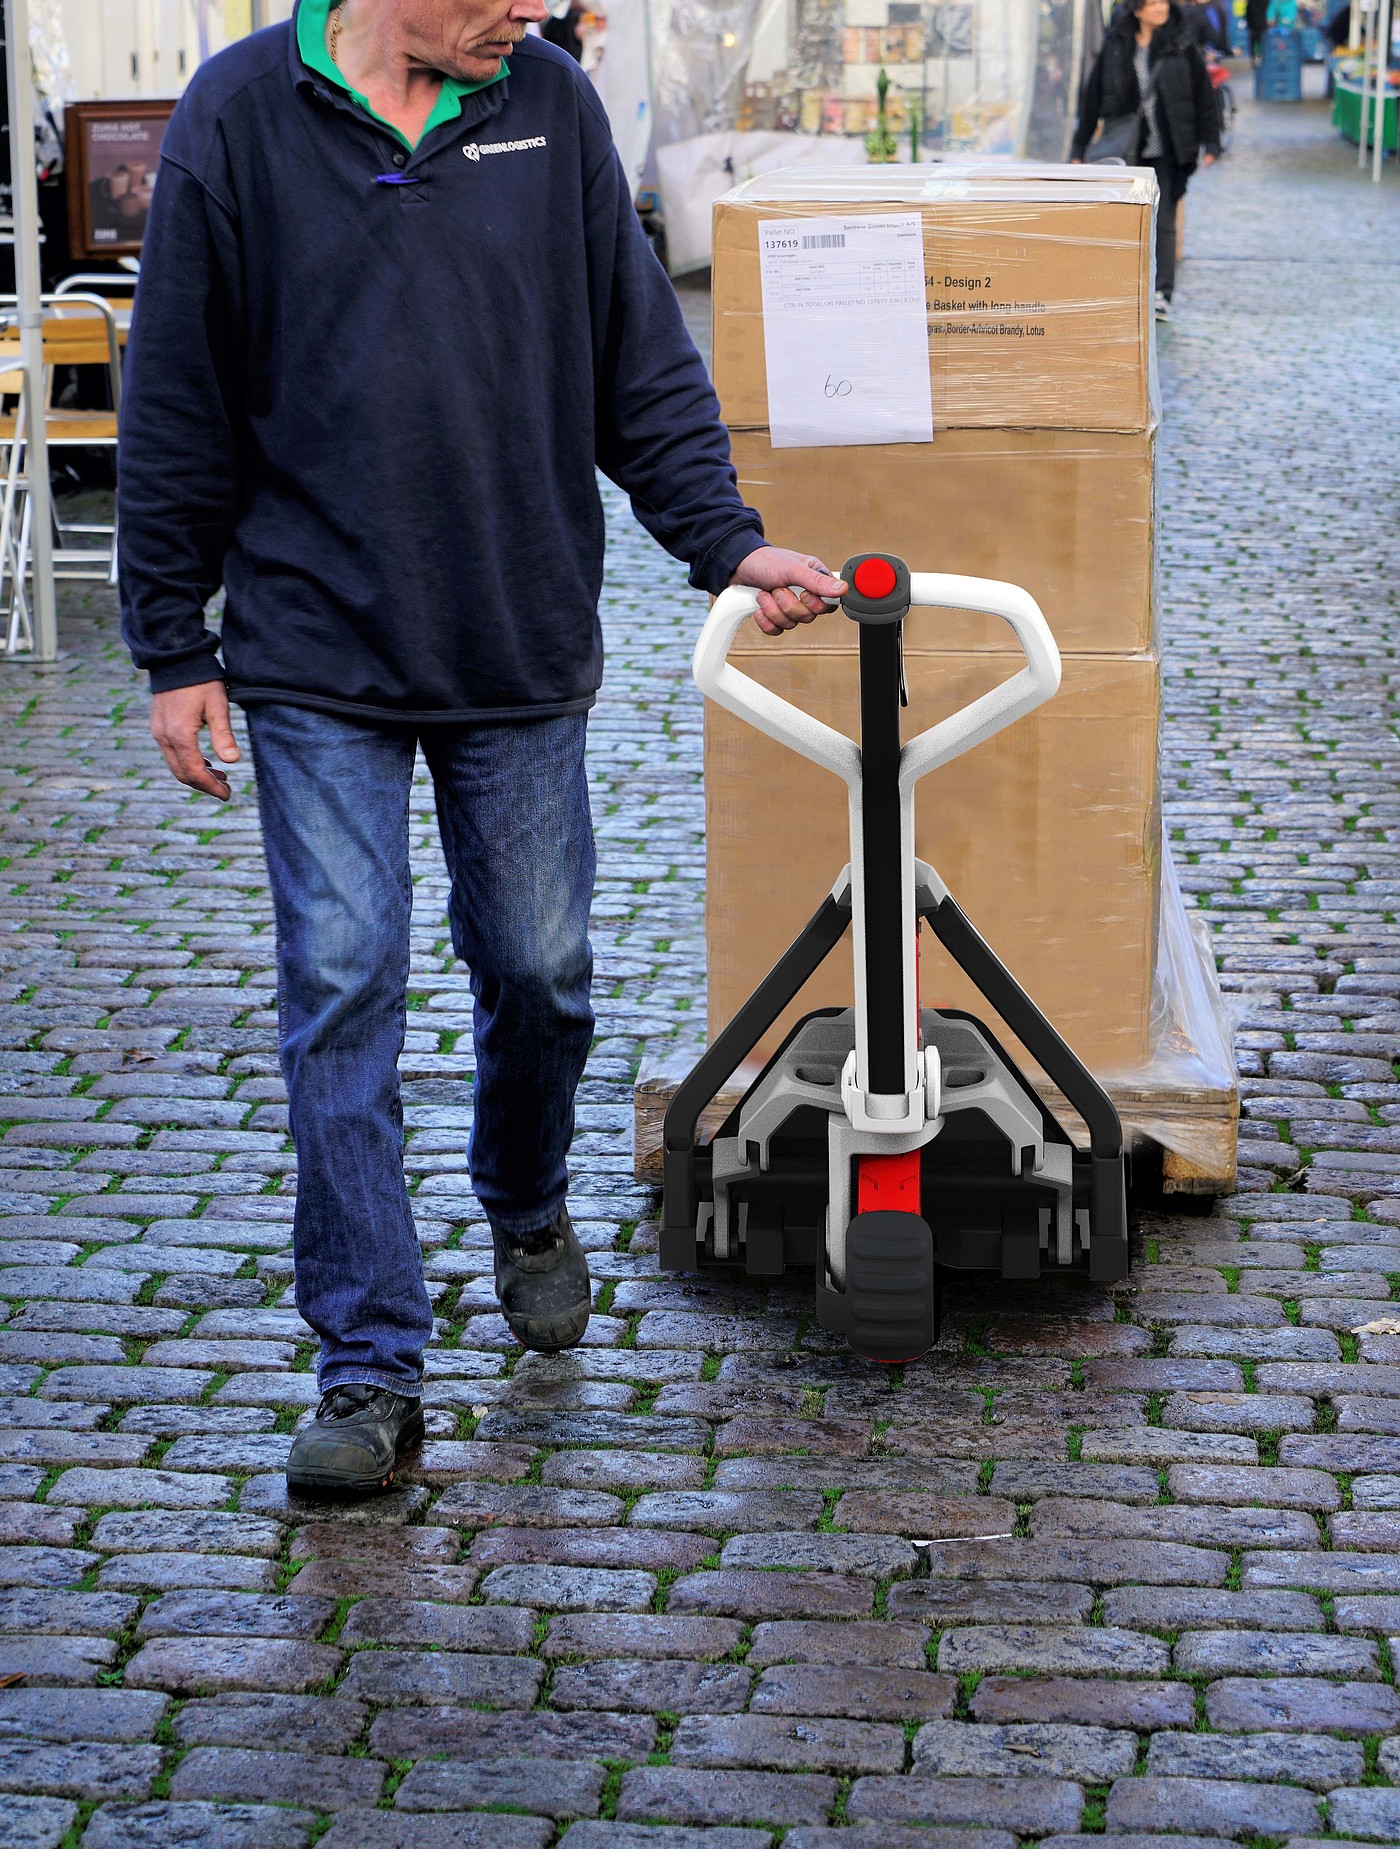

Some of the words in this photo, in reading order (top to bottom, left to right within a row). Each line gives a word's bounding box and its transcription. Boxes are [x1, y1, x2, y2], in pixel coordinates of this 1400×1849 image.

[765, 228, 783, 236] Pallet
[765, 240, 798, 249] 137619
[945, 277, 981, 290] Design
[985, 277, 991, 288] 2
[934, 300, 966, 311] Basket
[969, 300, 988, 311] with
[991, 301, 1011, 314] long
[1000, 324, 1025, 338] Brandy,
[1027, 325, 1045, 336] Lotus
[824, 374, 852, 398] 60
